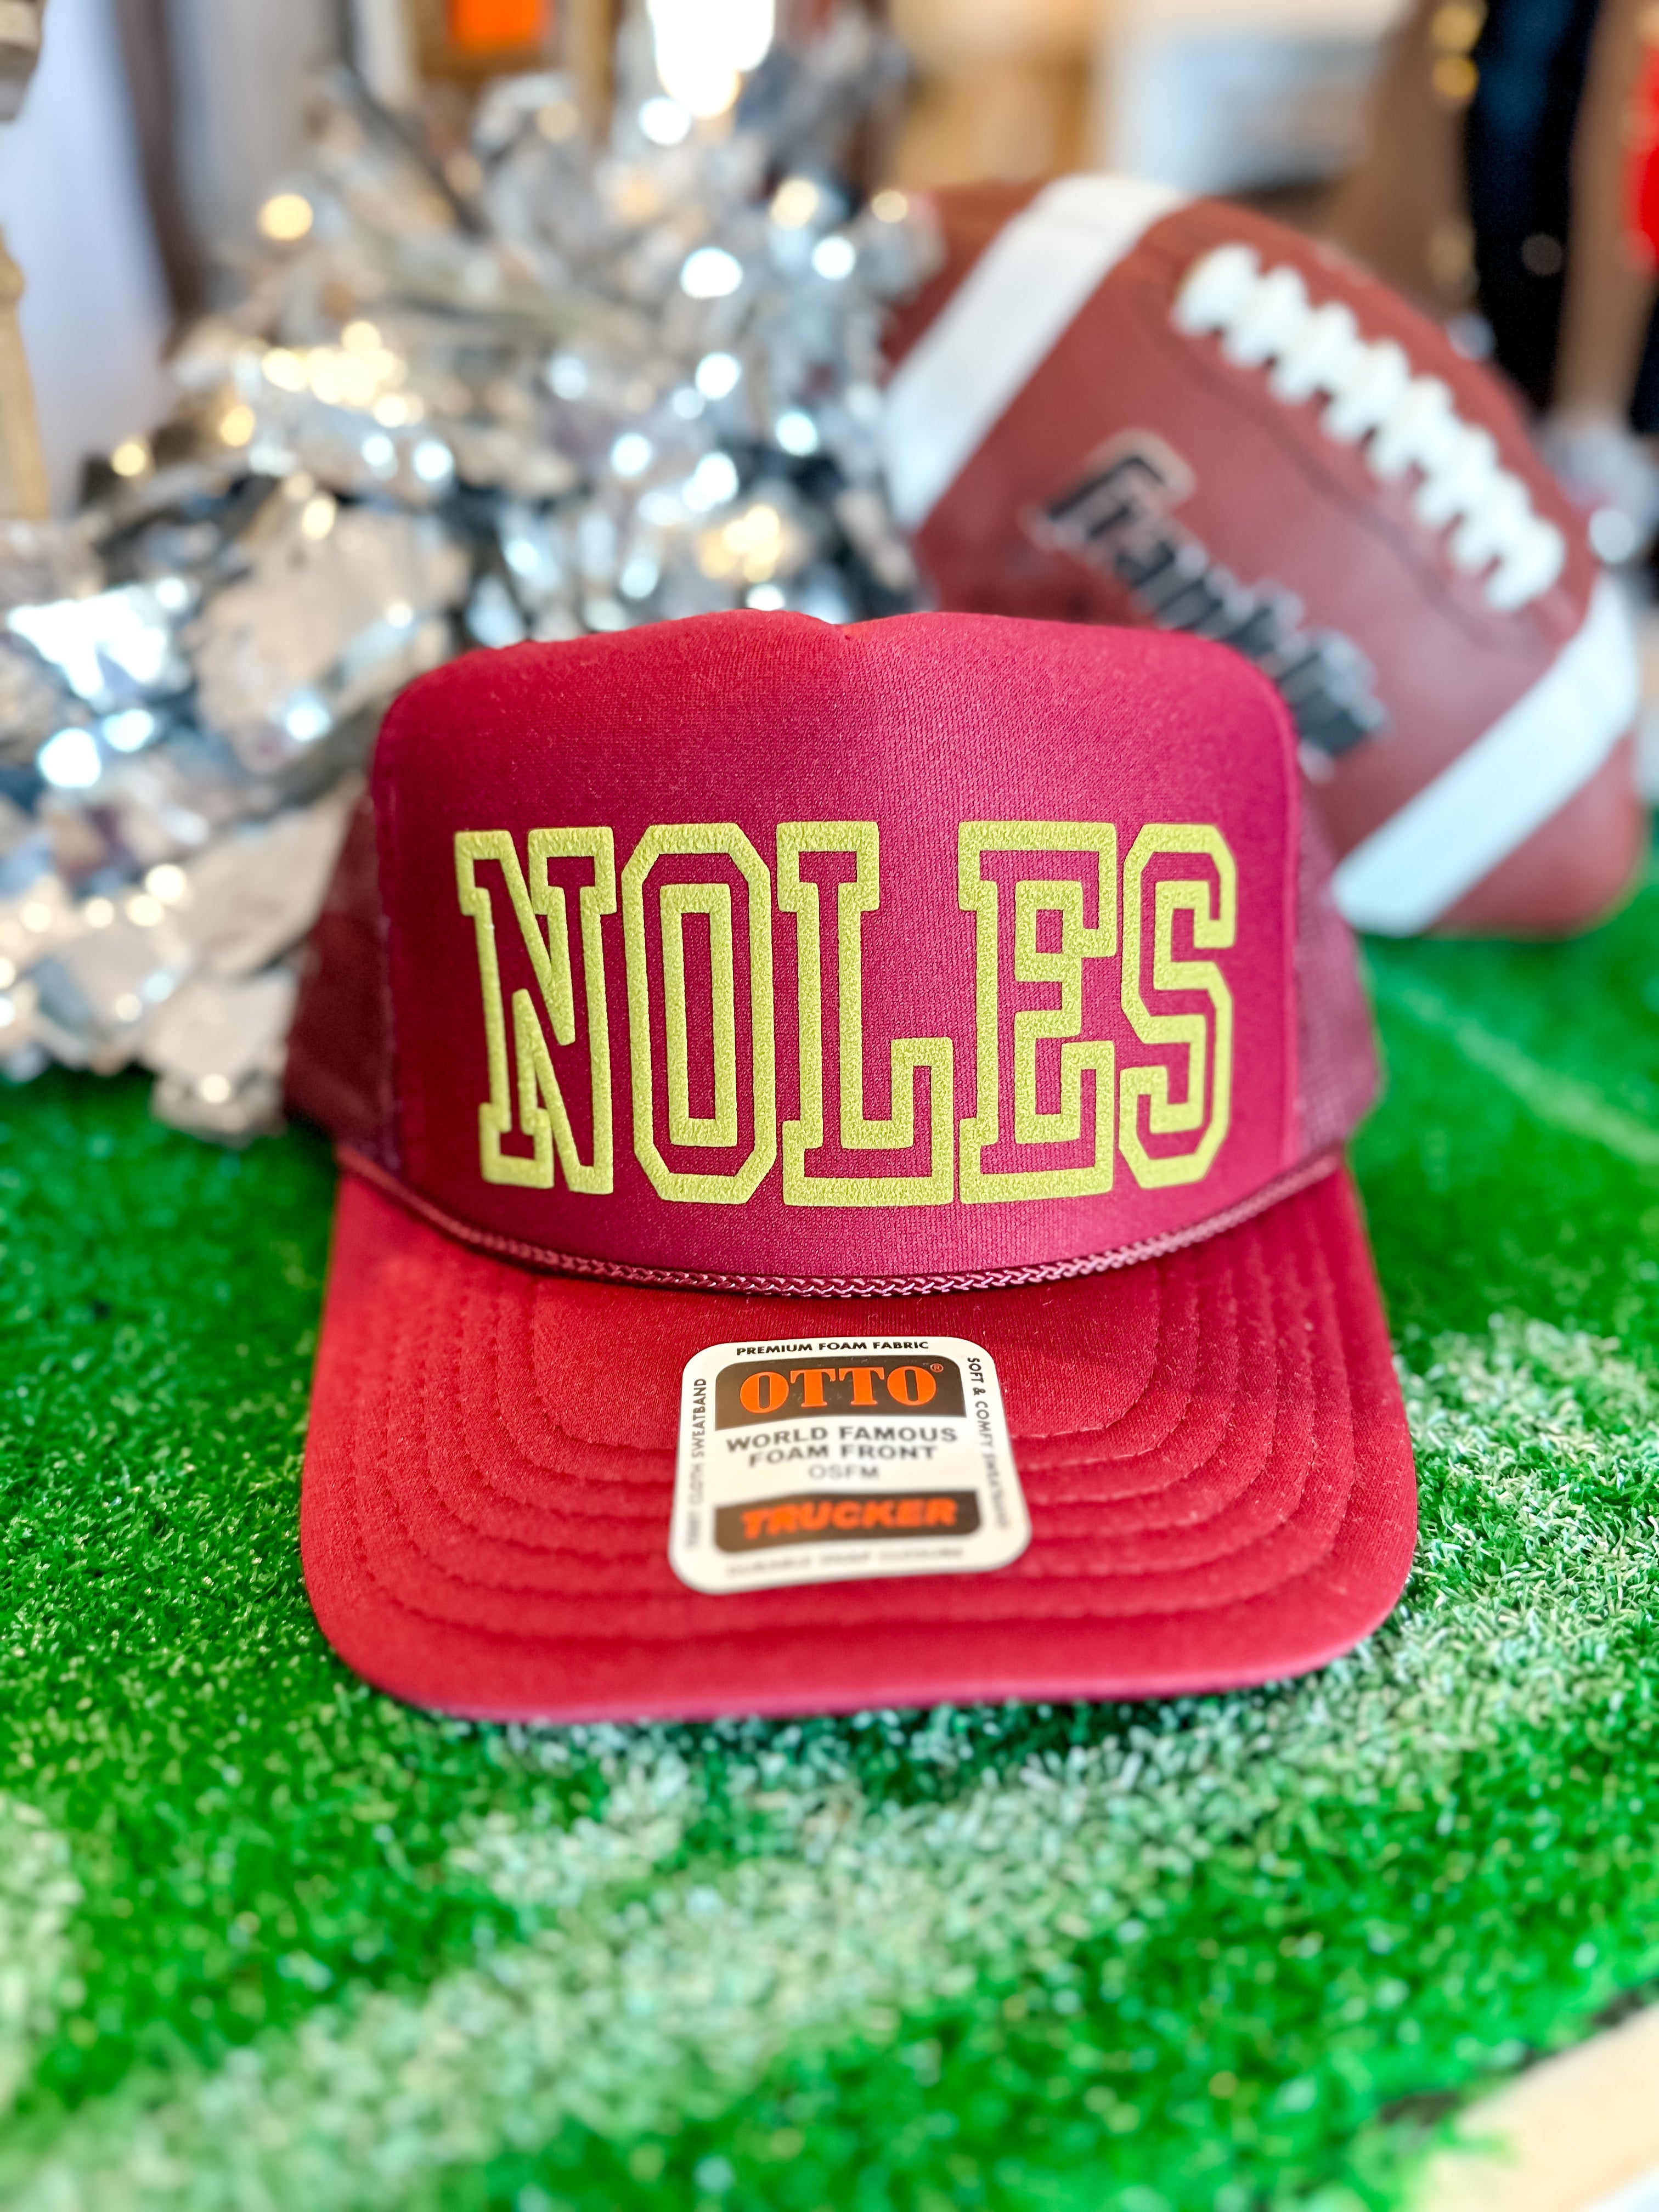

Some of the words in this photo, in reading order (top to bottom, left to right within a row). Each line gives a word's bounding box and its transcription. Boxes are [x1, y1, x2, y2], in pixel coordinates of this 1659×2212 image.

[454, 820, 1237, 1206] NOLES
[737, 1344, 812, 1356] PREMIUM
[819, 1342, 867, 1350] FOAM
[873, 1341, 929, 1350] FABRIC
[967, 1357, 984, 1383] SOFT
[973, 1386, 986, 1396] &
[692, 1378, 707, 1458] SWEATBAND
[975, 1401, 994, 1449] COMFY
[726, 1426, 828, 1453] WORLD
[839, 1426, 958, 1443] FAMOUS
[749, 1444, 828, 1467] FOAM
[840, 1444, 937, 1459] FRONT
[808, 1464, 879, 1480] OSFM
[740, 1497, 958, 1541] TRUCKER
